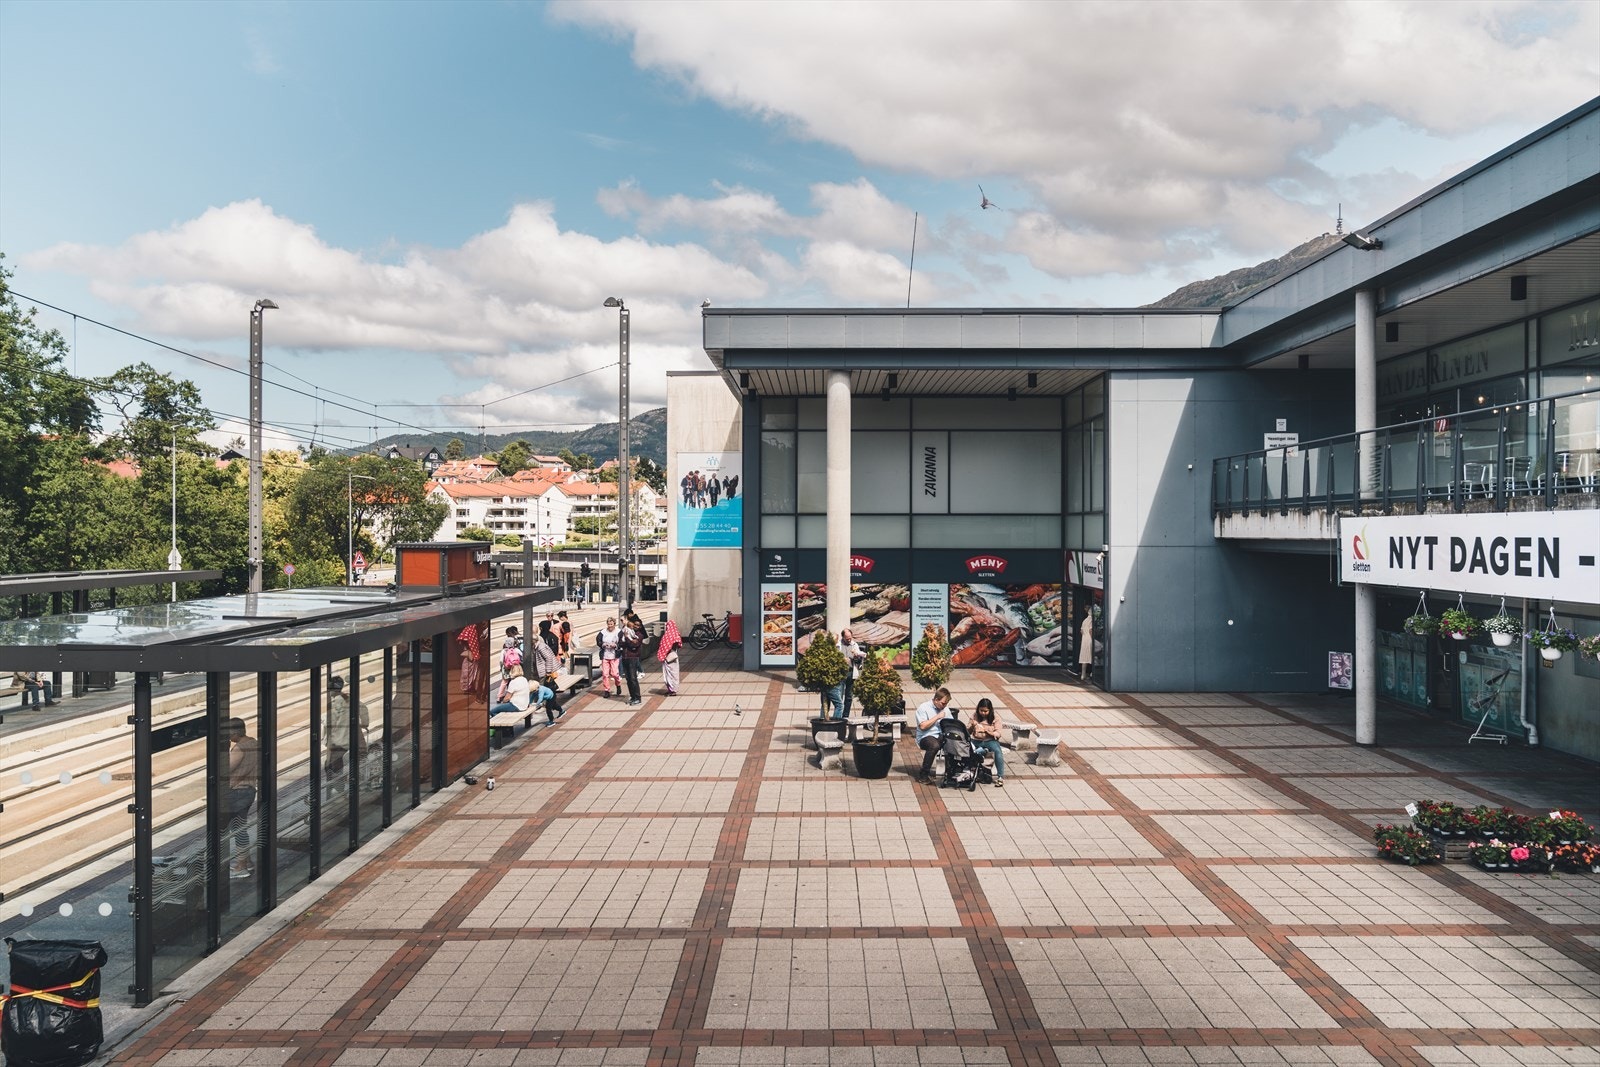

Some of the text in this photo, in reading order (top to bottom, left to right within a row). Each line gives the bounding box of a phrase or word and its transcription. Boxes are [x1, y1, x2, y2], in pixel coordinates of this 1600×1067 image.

[924, 446, 936, 498] ZAVANNA
[1389, 536, 1438, 570] NYT
[1450, 536, 1560, 578] DAGEN
[850, 558, 870, 569] ENY
[970, 558, 1004, 569] MENY
[1353, 561, 1371, 572] sletten
